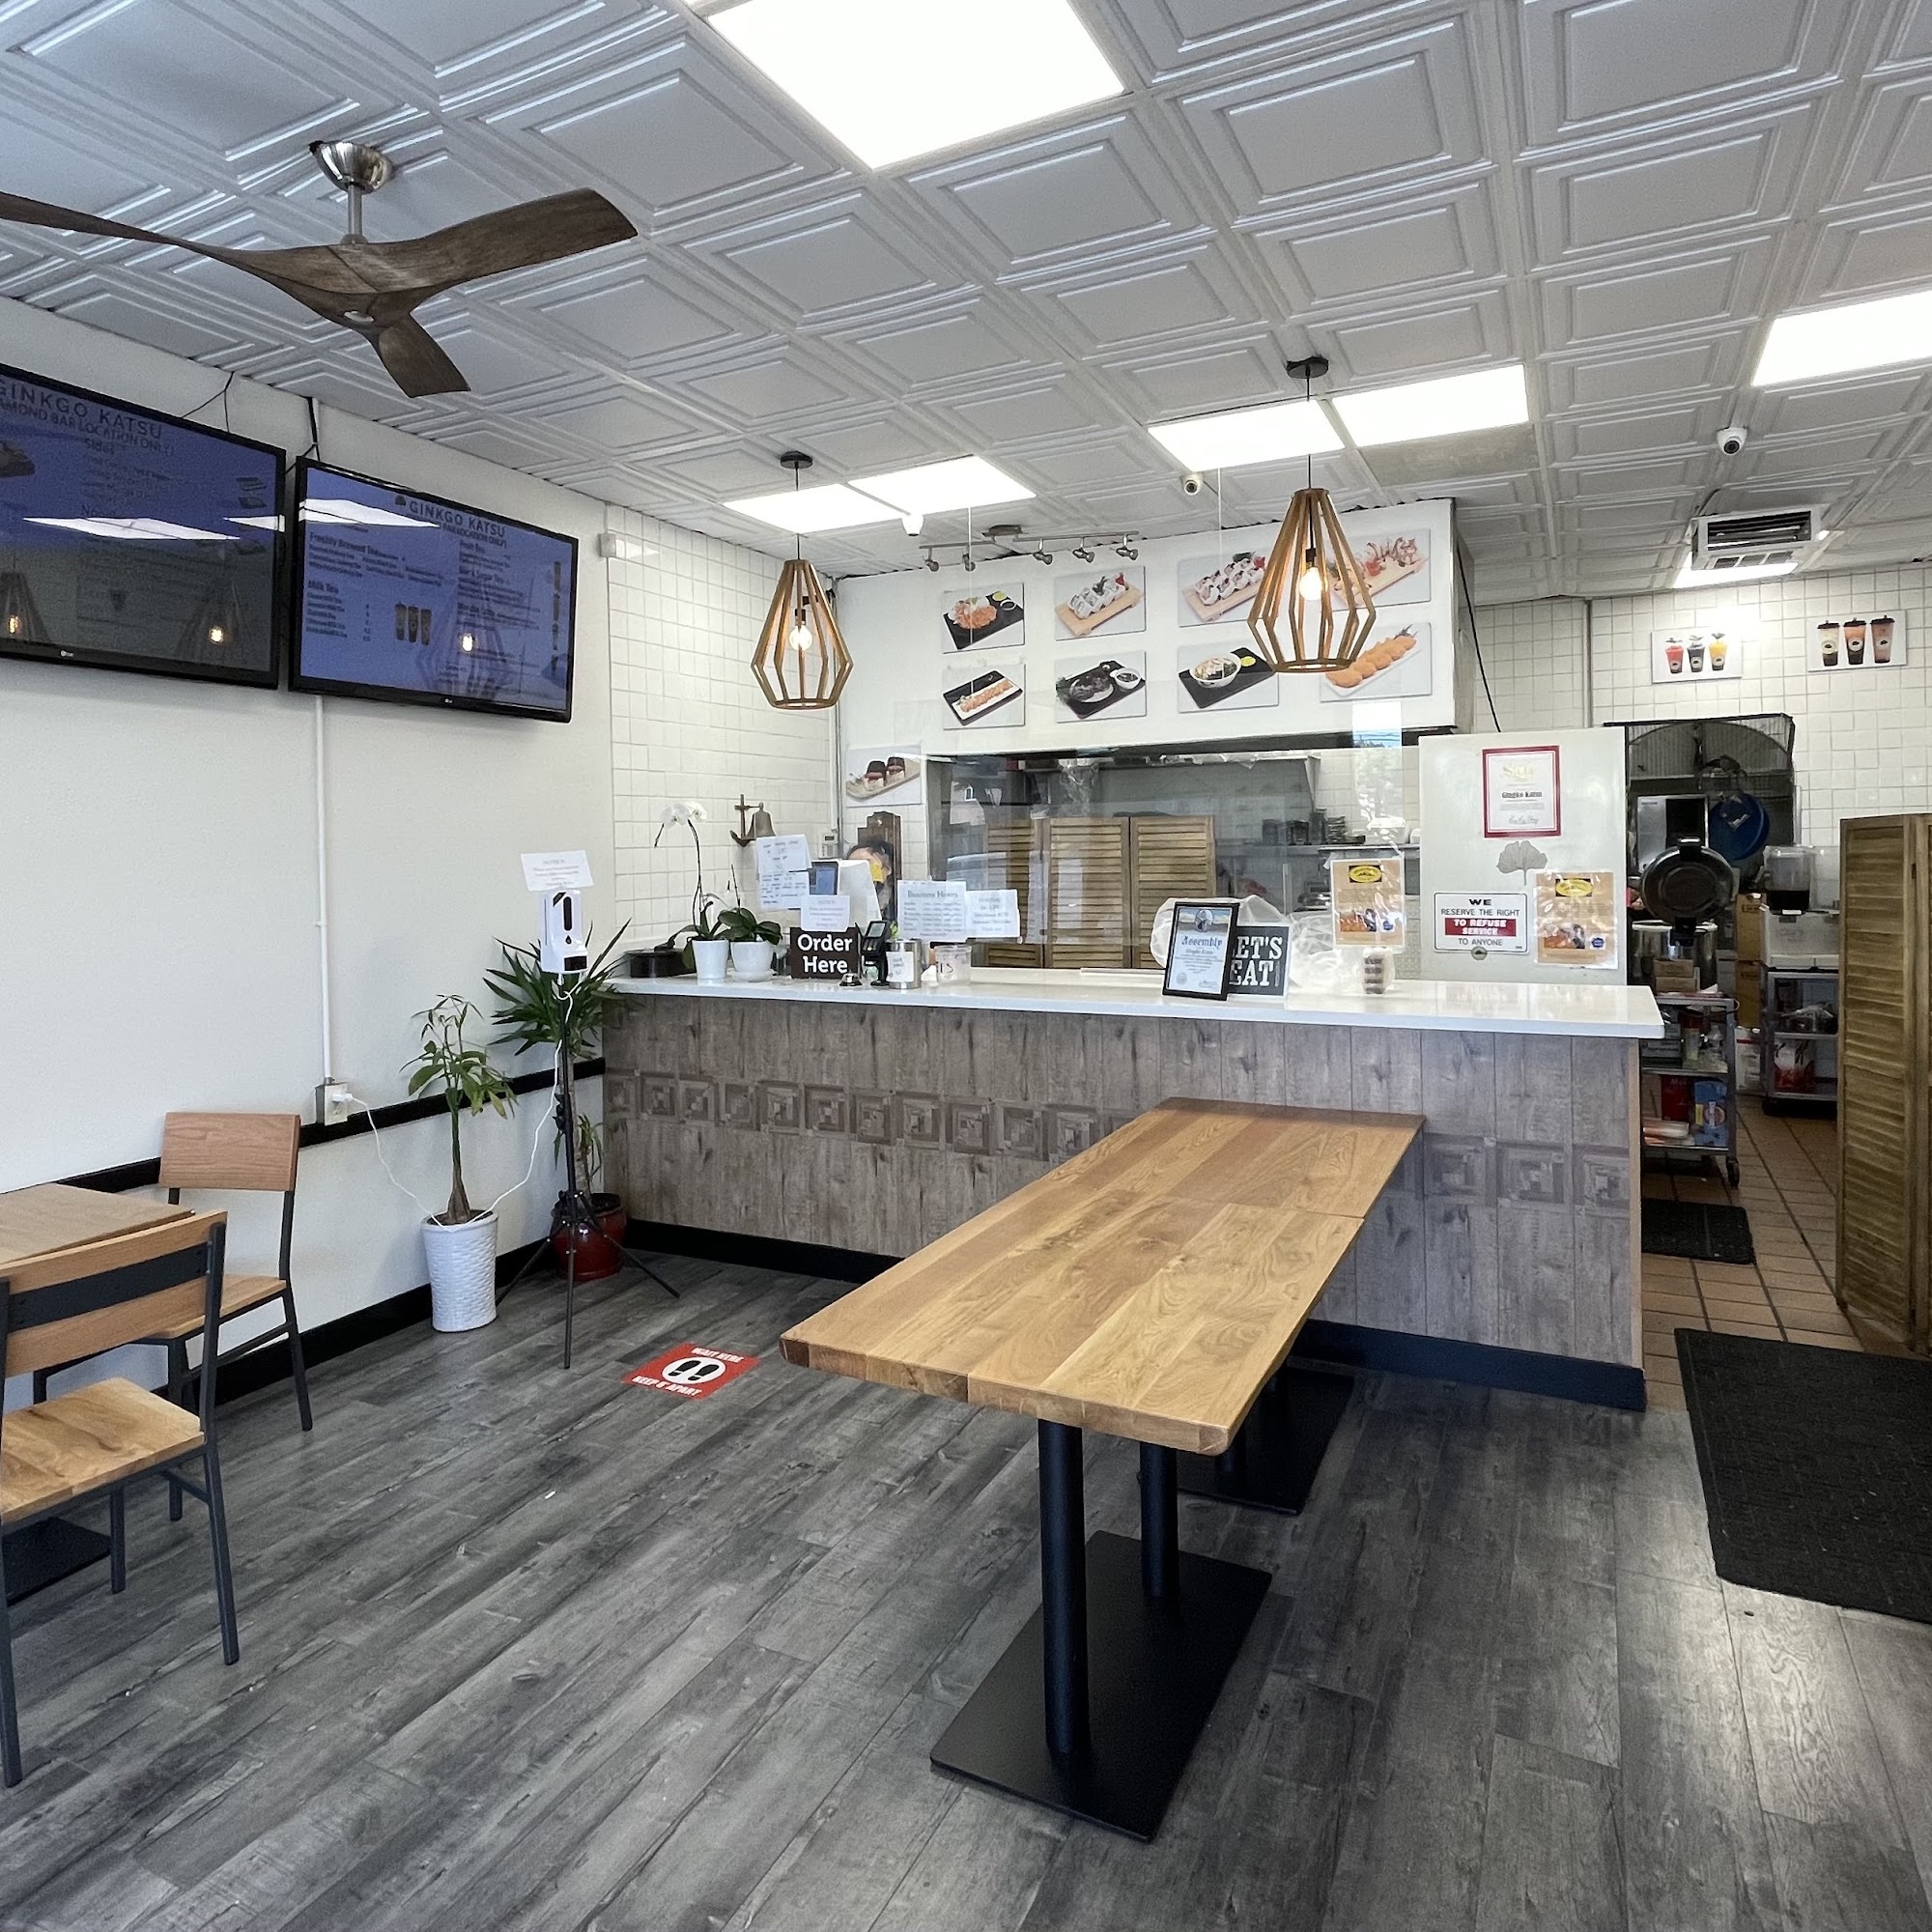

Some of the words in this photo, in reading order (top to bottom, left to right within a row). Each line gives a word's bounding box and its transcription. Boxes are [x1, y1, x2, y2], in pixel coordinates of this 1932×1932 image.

[99, 409, 162, 440] KATSU
[410, 500, 463, 526] GINKGO
[469, 515, 505, 538] KATSU
[1453, 919, 1467, 927] TO
[1469, 919, 1507, 928] REFUSE
[797, 933, 853, 952] Order
[1180, 935, 1224, 950] Assembly
[1232, 935, 1283, 959] ET'S
[1458, 937, 1469, 946] TO
[1471, 938, 1503, 947] ANYONE
[802, 955, 848, 974] Here
[631, 1375, 659, 1386] KEEP
[665, 1383, 702, 1397] APART
